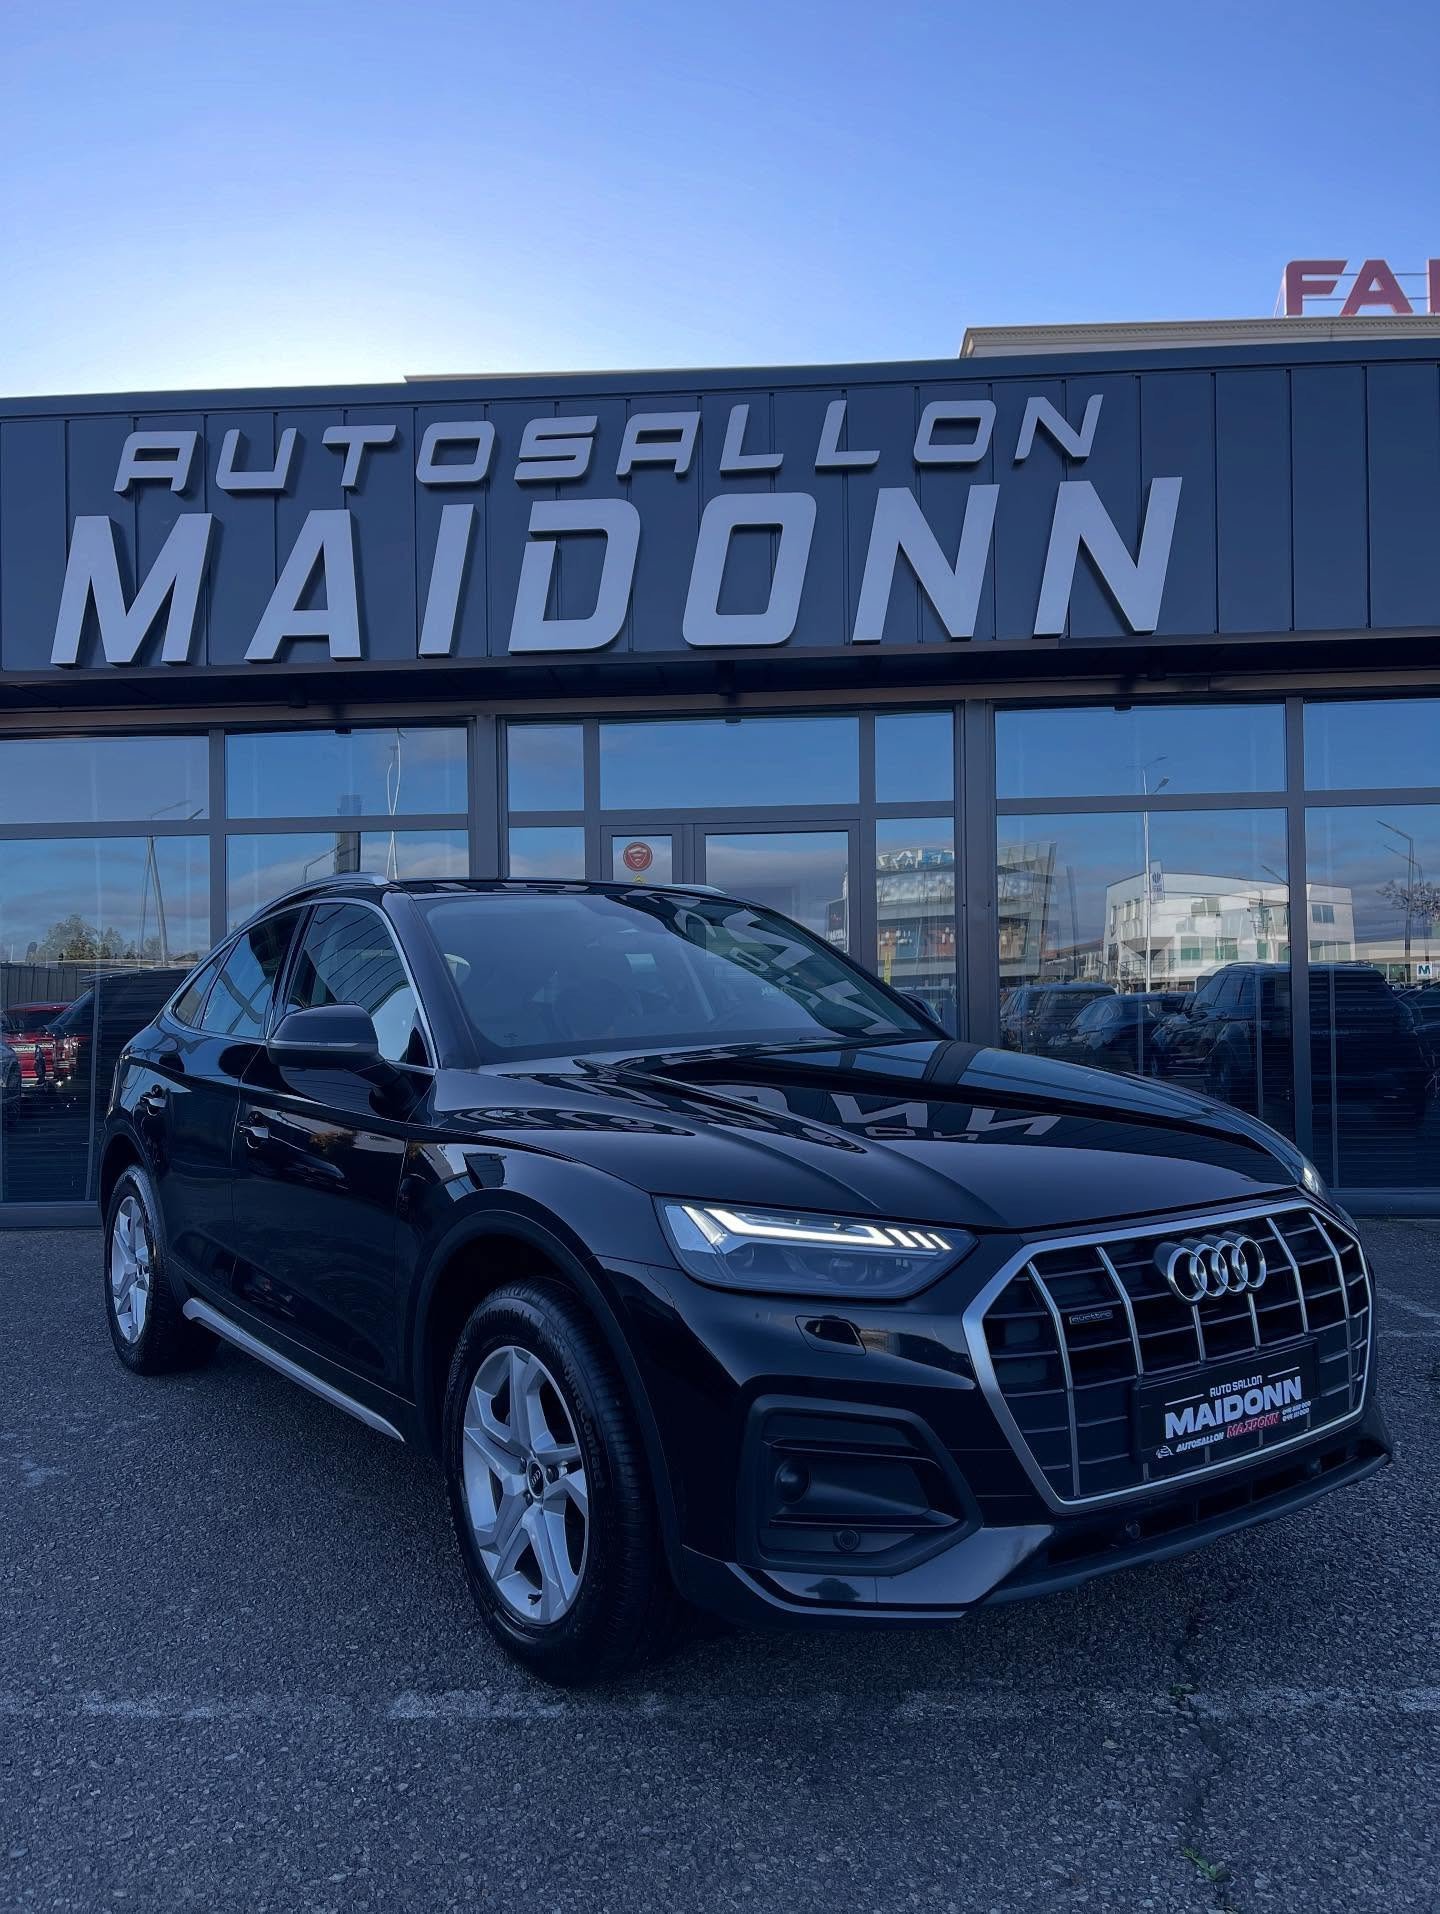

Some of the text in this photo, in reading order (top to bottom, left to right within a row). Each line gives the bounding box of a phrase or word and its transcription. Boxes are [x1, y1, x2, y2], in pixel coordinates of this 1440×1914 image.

[1285, 259, 1440, 316] FA
[113, 393, 1104, 495] AUTOSALLON
[50, 476, 1183, 666] MAIDONN
[1164, 1375, 1303, 1440] MAIDONN
[1232, 1375, 1263, 1392] SALLON
[1175, 1431, 1225, 1453] AUTOSALLON
